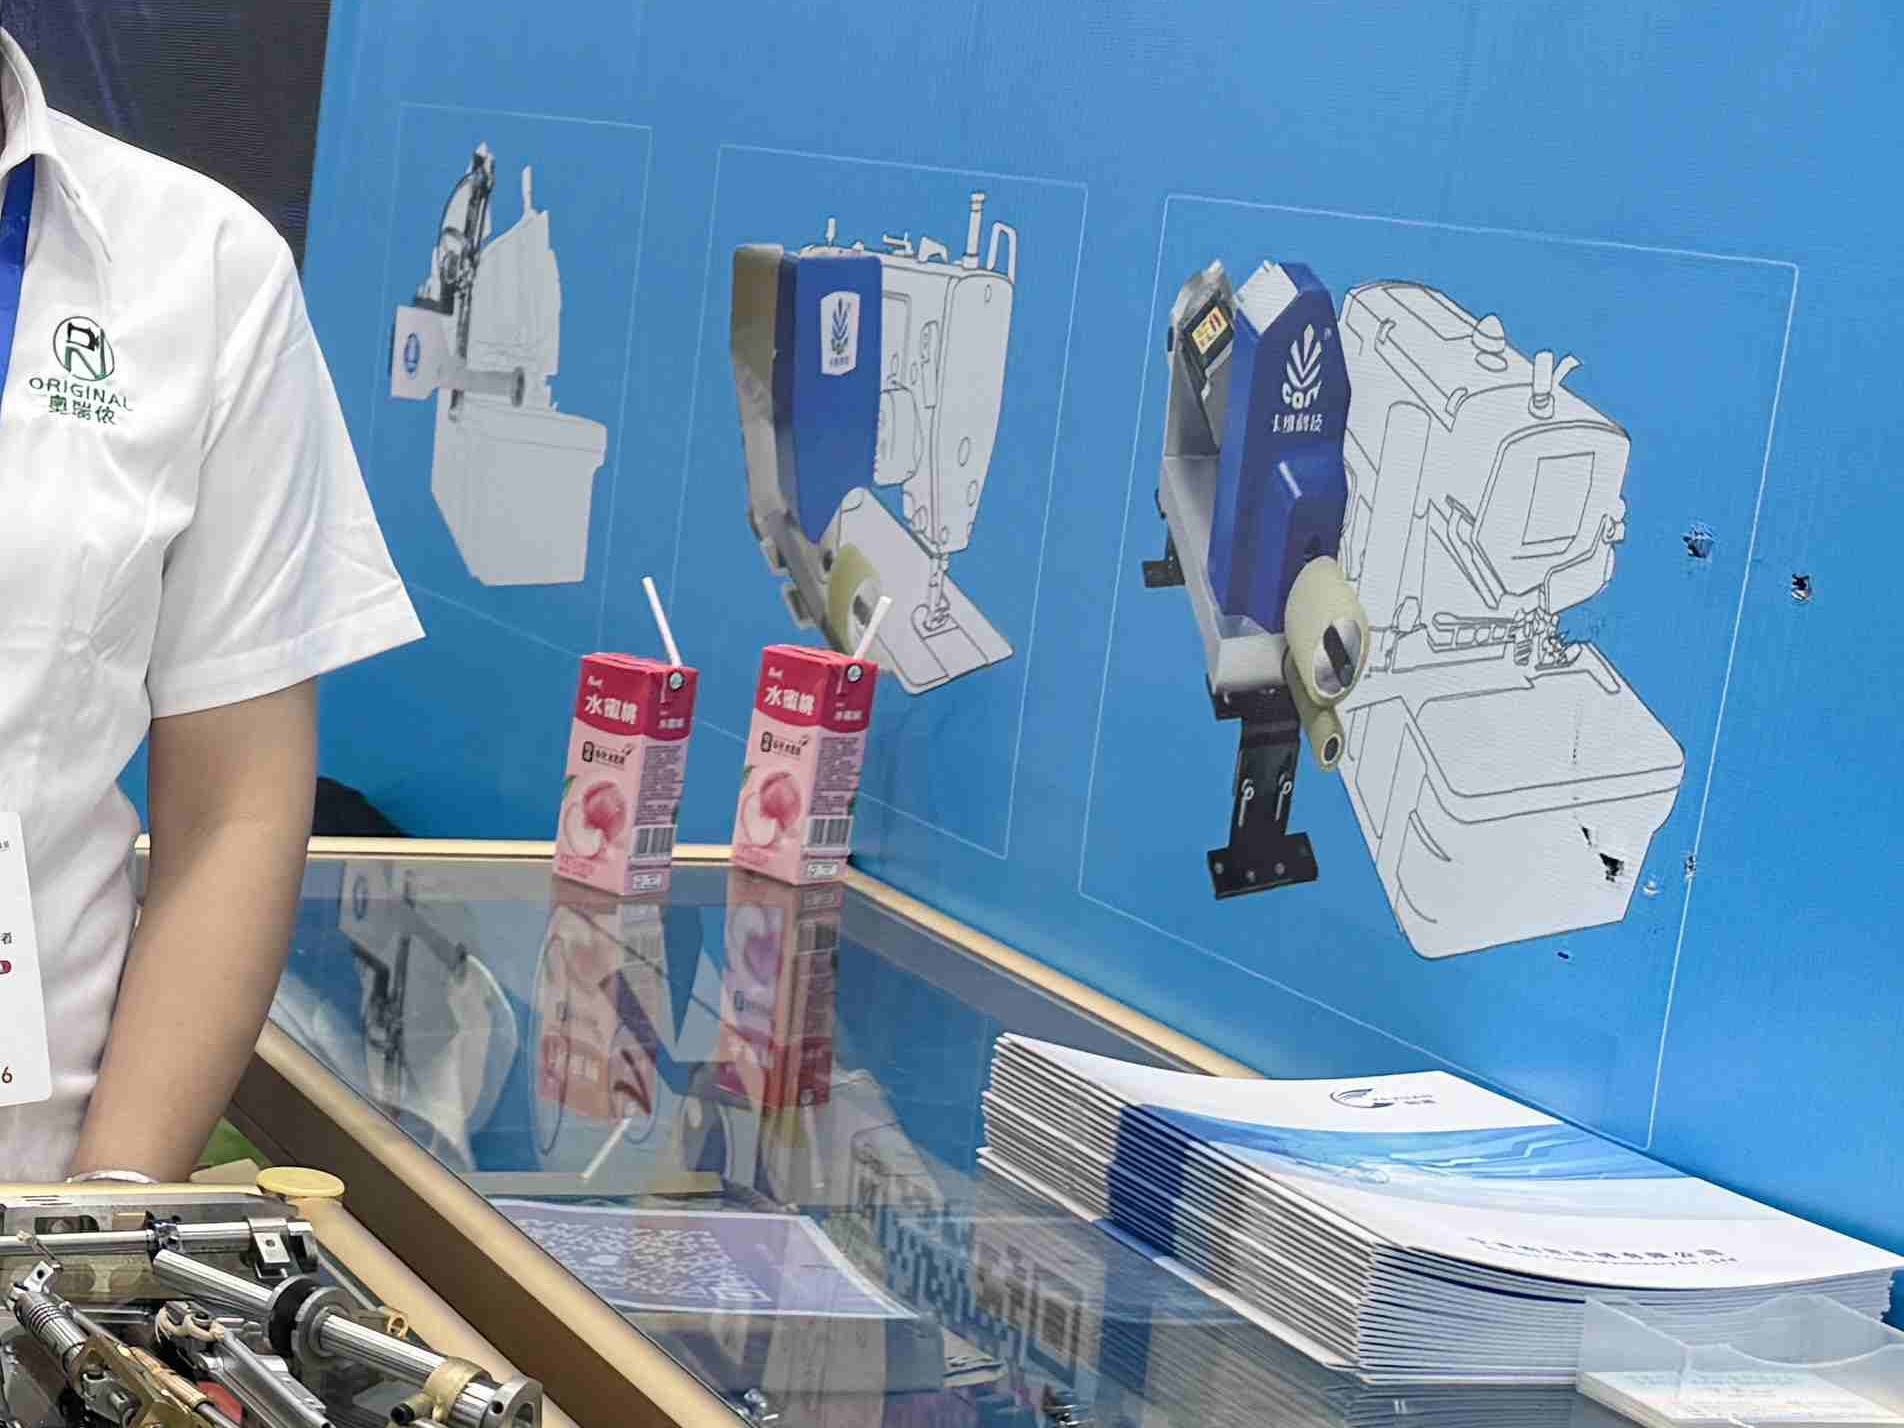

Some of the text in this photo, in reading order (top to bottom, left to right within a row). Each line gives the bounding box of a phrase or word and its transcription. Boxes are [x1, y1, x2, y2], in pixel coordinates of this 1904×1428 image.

[28, 376, 134, 412] ORIGINAL
[584, 693, 640, 726] 水蜜桃
[763, 684, 817, 716] 水蜜桃
